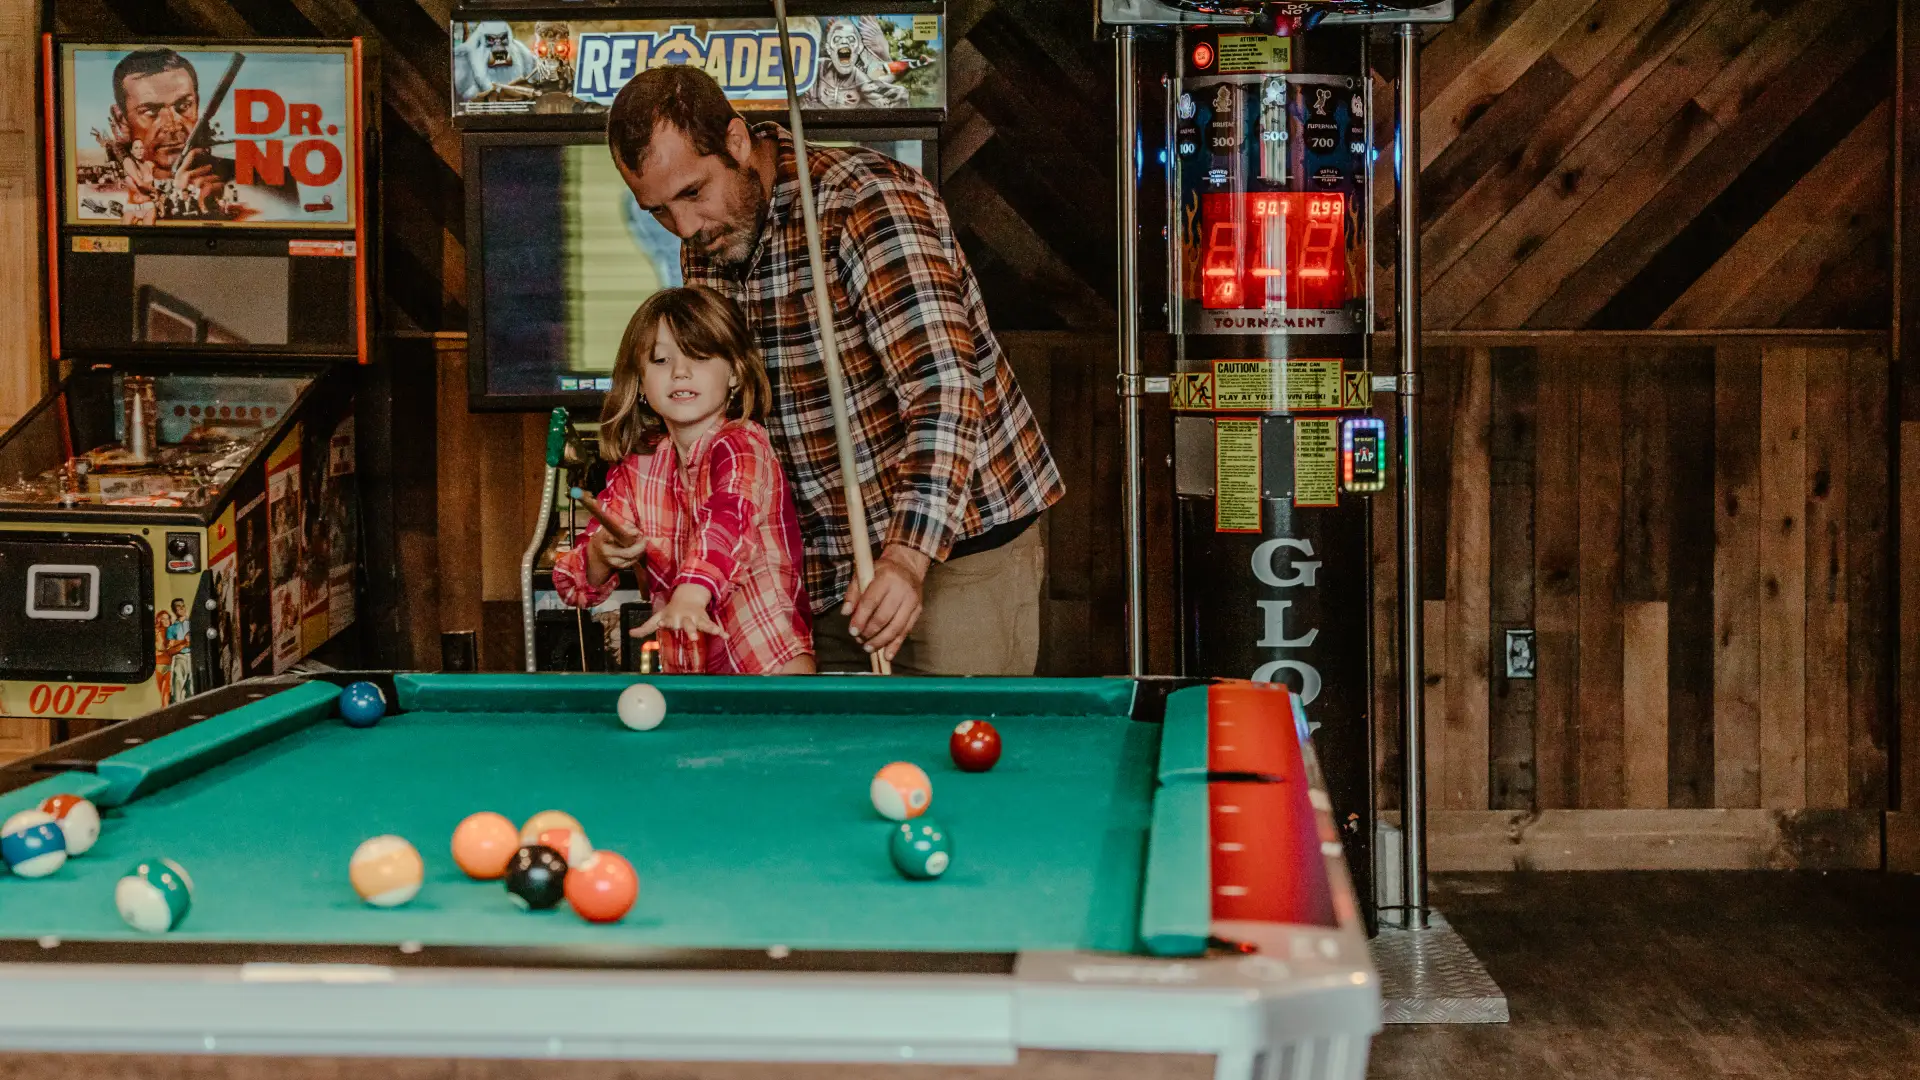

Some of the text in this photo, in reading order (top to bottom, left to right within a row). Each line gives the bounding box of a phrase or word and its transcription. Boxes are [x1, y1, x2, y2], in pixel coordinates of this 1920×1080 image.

[1281, 6, 1313, 15] NOT
[581, 33, 812, 93] RELOADED
[1263, 131, 1289, 141] 500
[1212, 137, 1235, 147] 300
[1312, 138, 1334, 148] 700
[1180, 143, 1195, 154] 100
[1351, 143, 1365, 153] 900
[235, 139, 343, 186] NO
[1257, 201, 1288, 214] 90.7
[1214, 317, 1326, 329] TOURNAMENT
[1218, 362, 1260, 373] CAUTION!
[1354, 452, 1374, 462] TAP
[29, 684, 99, 715] 007
